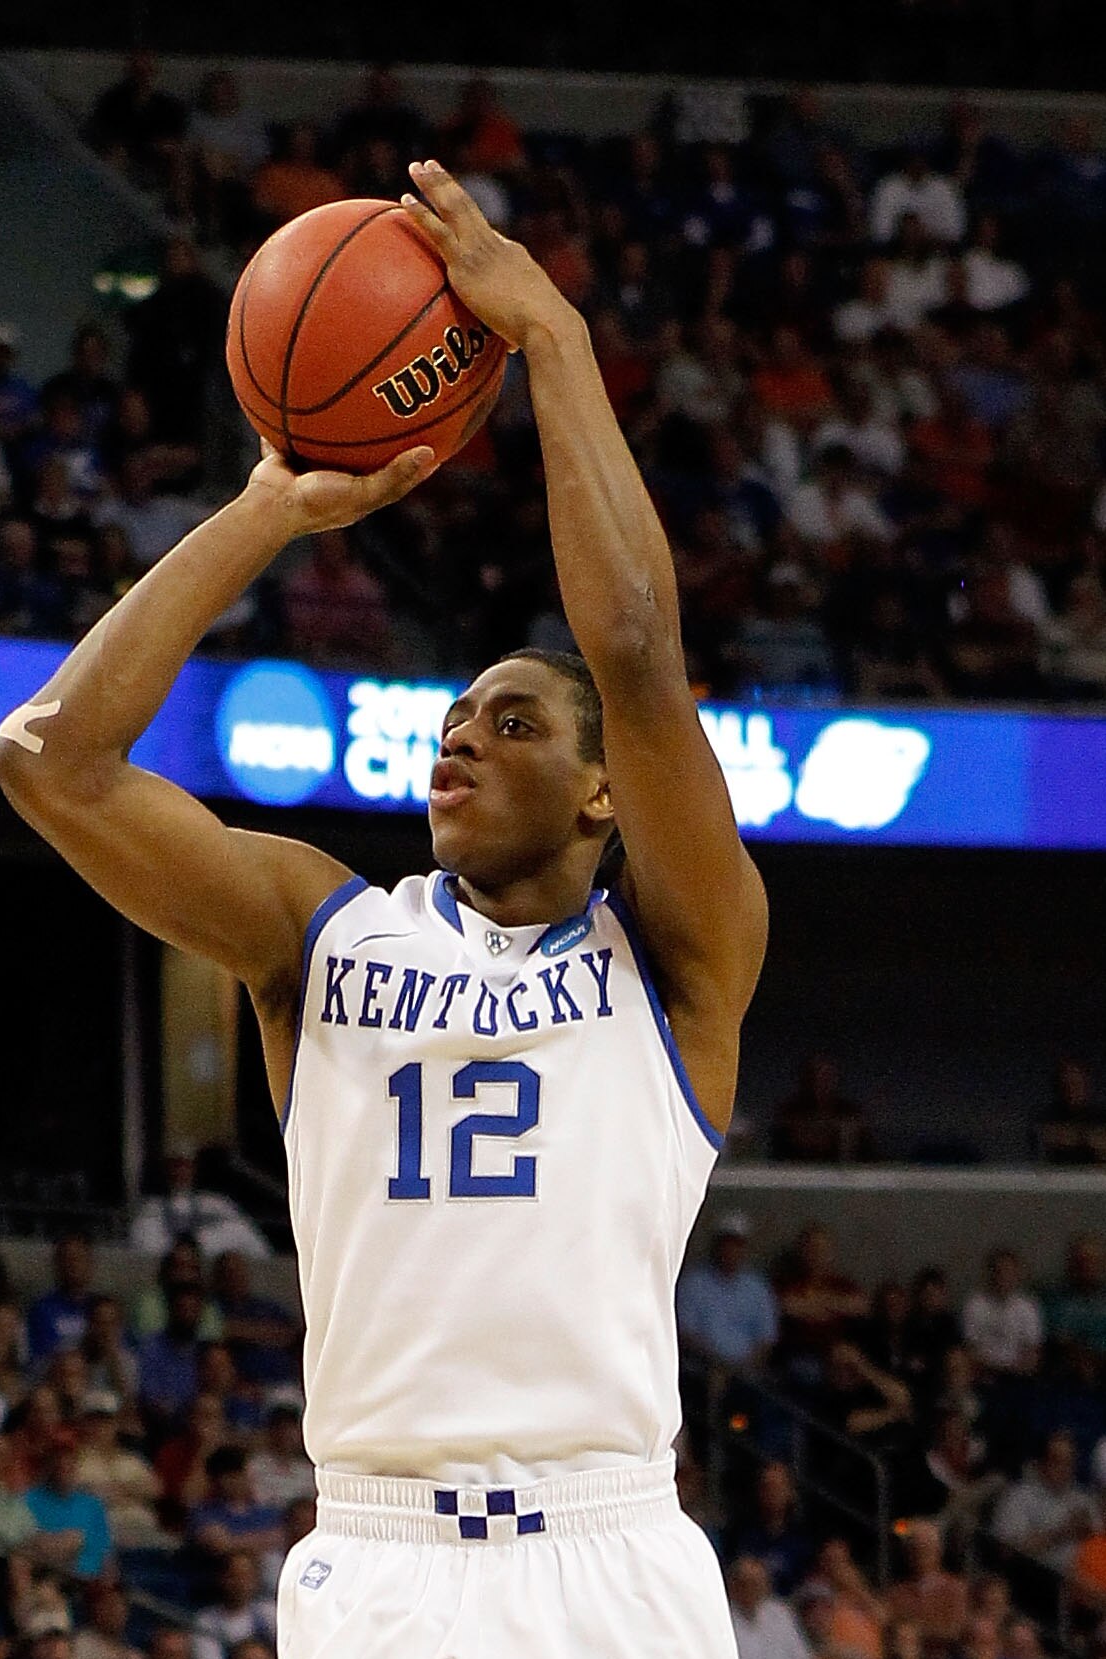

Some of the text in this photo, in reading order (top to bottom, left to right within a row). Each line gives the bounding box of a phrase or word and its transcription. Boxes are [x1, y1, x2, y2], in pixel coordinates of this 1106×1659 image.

[371, 323, 494, 419] Wils
[548, 923, 587, 955] NCAA
[320, 947, 614, 1037] KENTUCKY
[386, 1059, 542, 1202] 12
